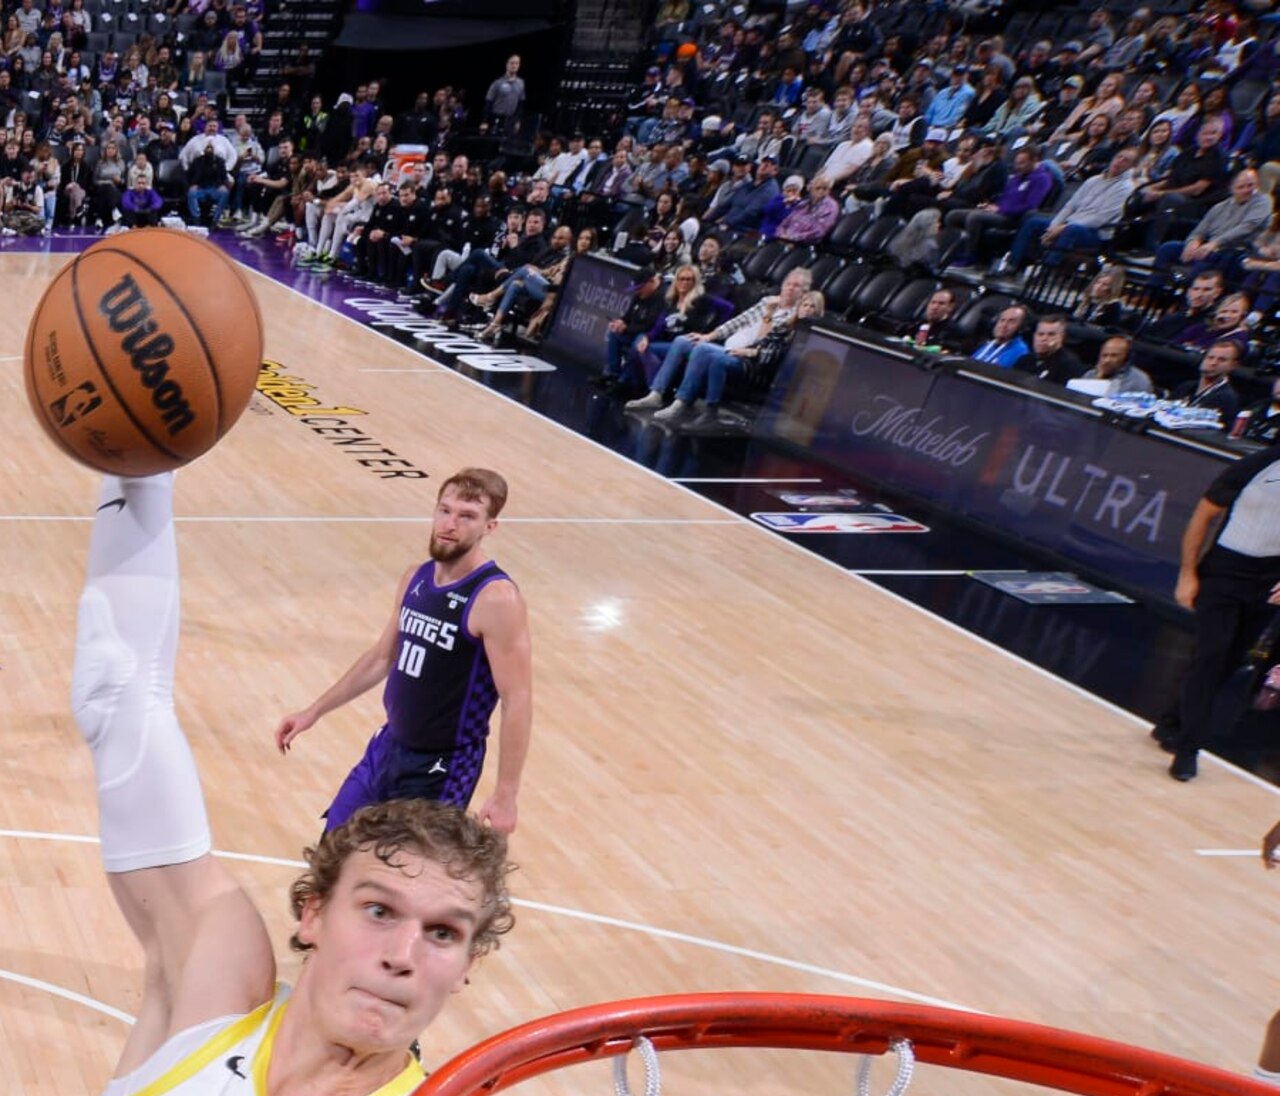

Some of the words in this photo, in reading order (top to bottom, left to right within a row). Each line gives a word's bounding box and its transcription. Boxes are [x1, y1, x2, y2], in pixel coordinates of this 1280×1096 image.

[577, 281, 632, 316] SUPERIO
[99, 271, 197, 437] Wilson
[300, 417, 429, 479] CENTER
[851, 395, 990, 467] Michelob
[1013, 445, 1167, 543] ULTRA
[399, 606, 458, 651] KINGS
[398, 640, 426, 679] 10
